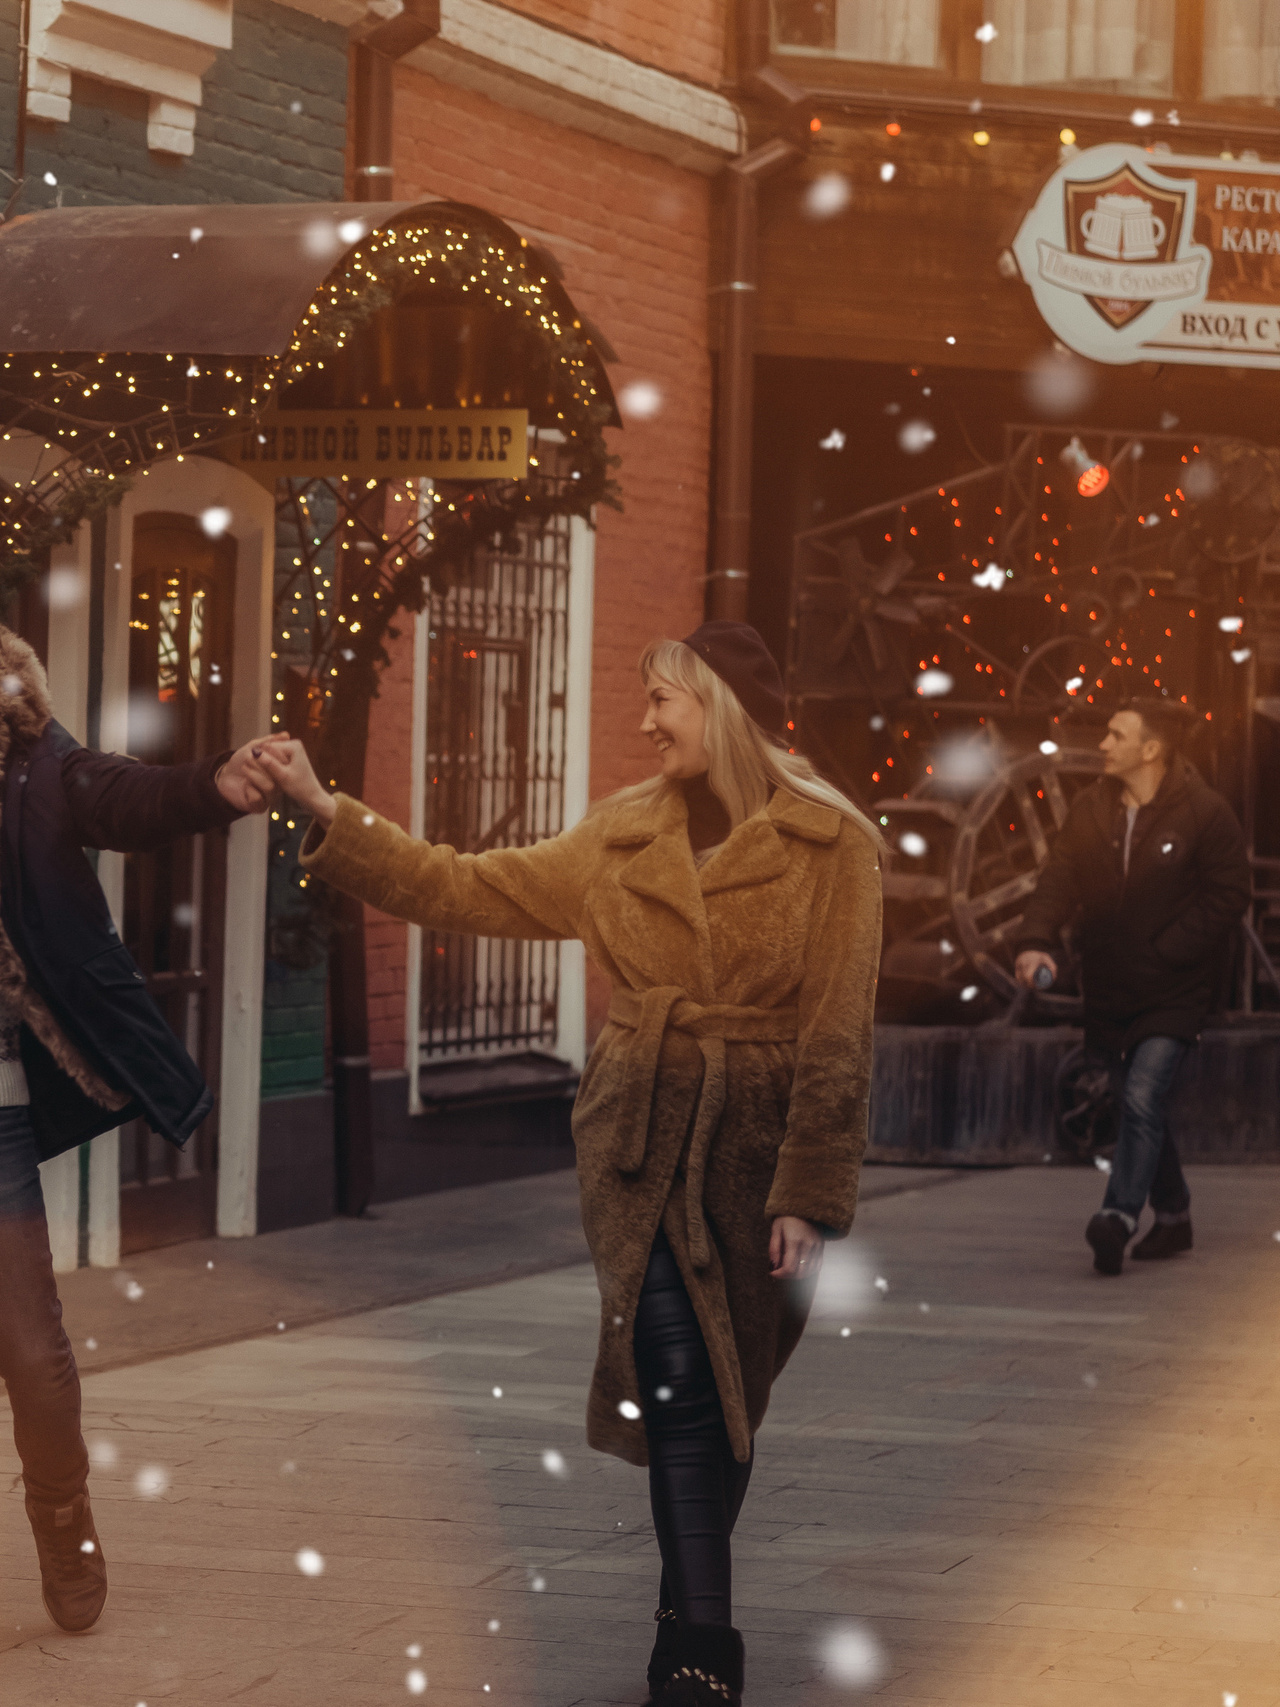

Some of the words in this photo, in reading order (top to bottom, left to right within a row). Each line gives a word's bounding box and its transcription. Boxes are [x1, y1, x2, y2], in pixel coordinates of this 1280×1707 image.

[1182, 315, 1248, 343] ВХОД
[239, 418, 359, 461] ПИВНОЙ
[376, 425, 513, 461] БУЛЬВАР
